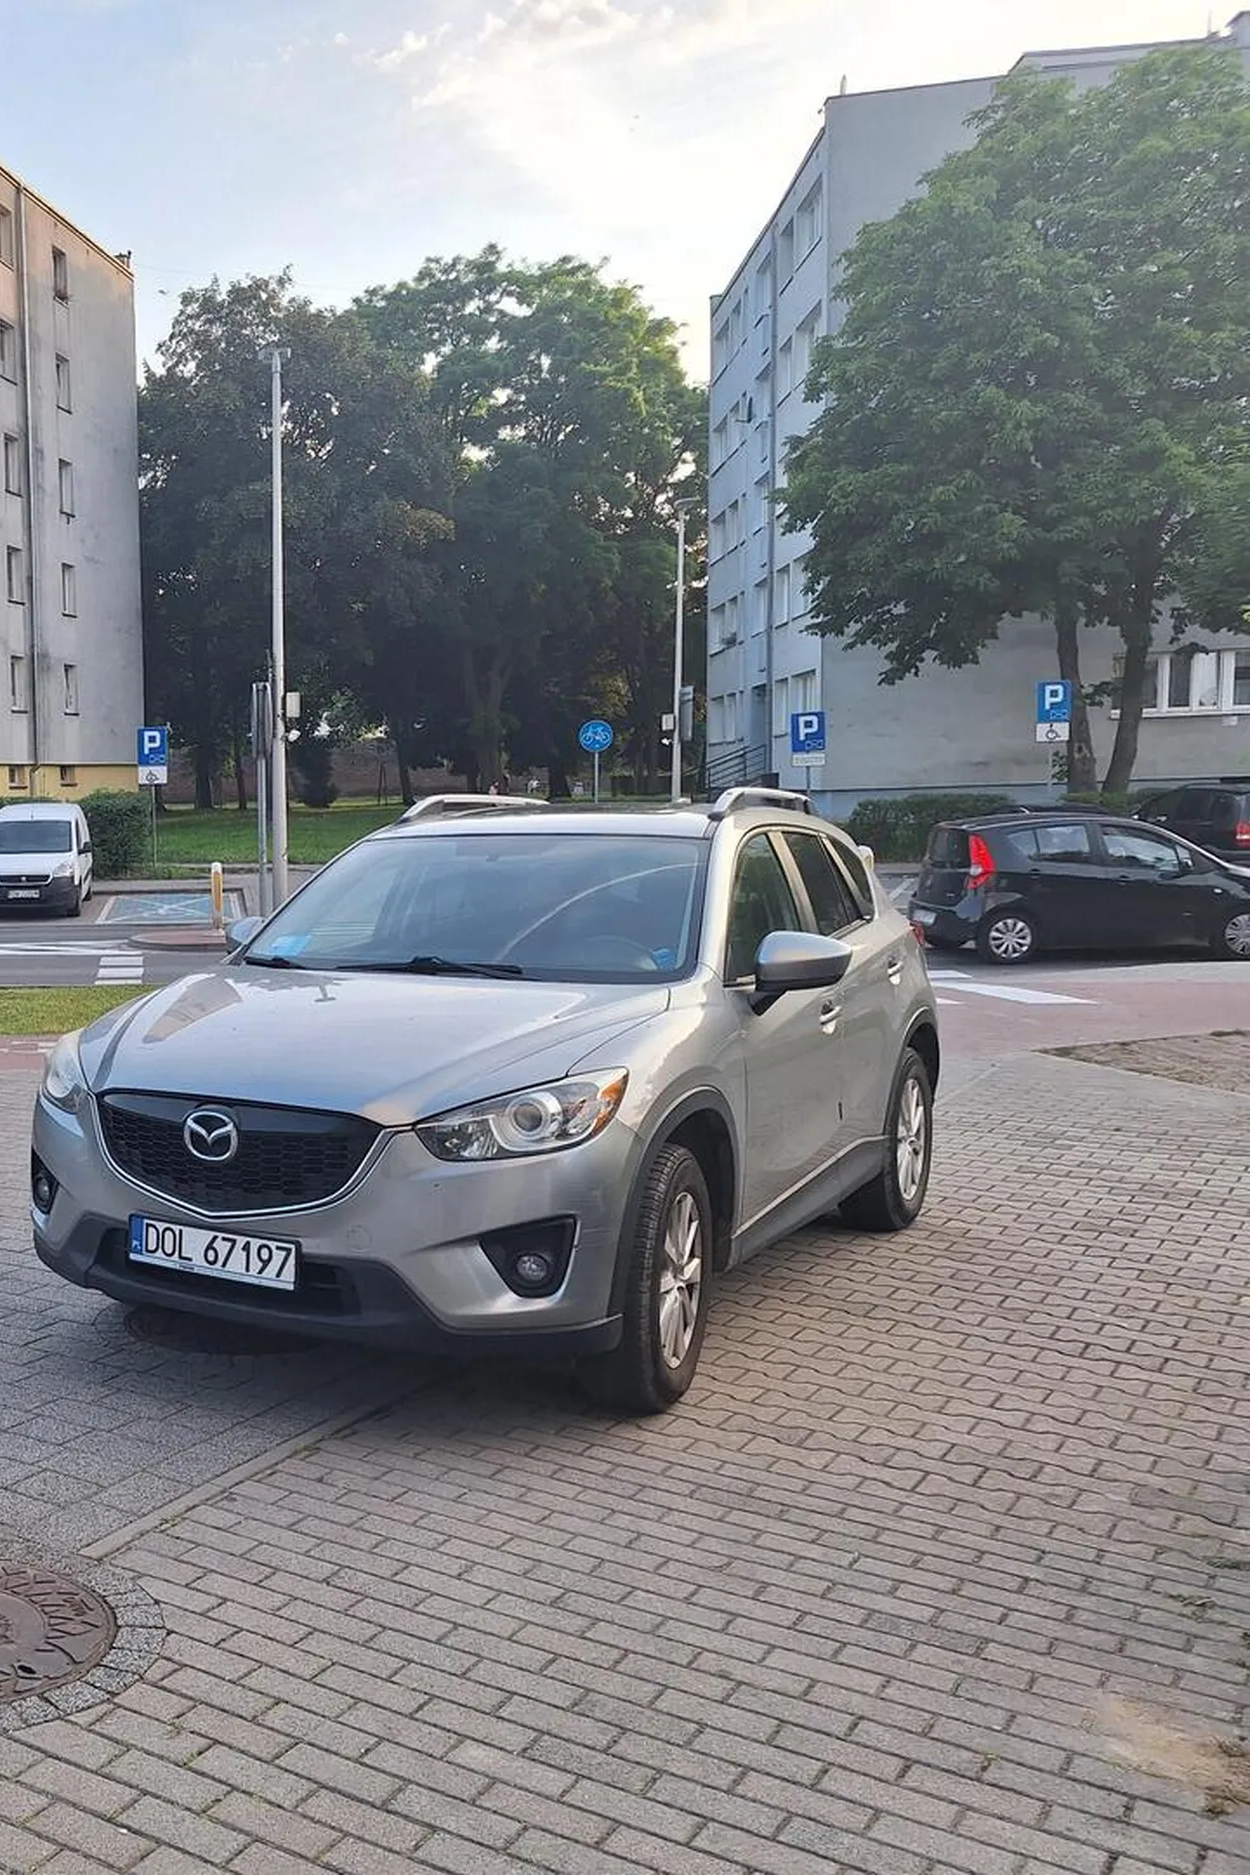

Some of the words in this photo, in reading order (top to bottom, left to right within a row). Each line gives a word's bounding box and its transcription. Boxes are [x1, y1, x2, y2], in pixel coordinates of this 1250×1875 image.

[1044, 684, 1063, 709] P
[799, 715, 819, 741] P
[143, 731, 161, 754] P
[144, 1222, 193, 1262] DOL
[203, 1234, 293, 1279] 67197
